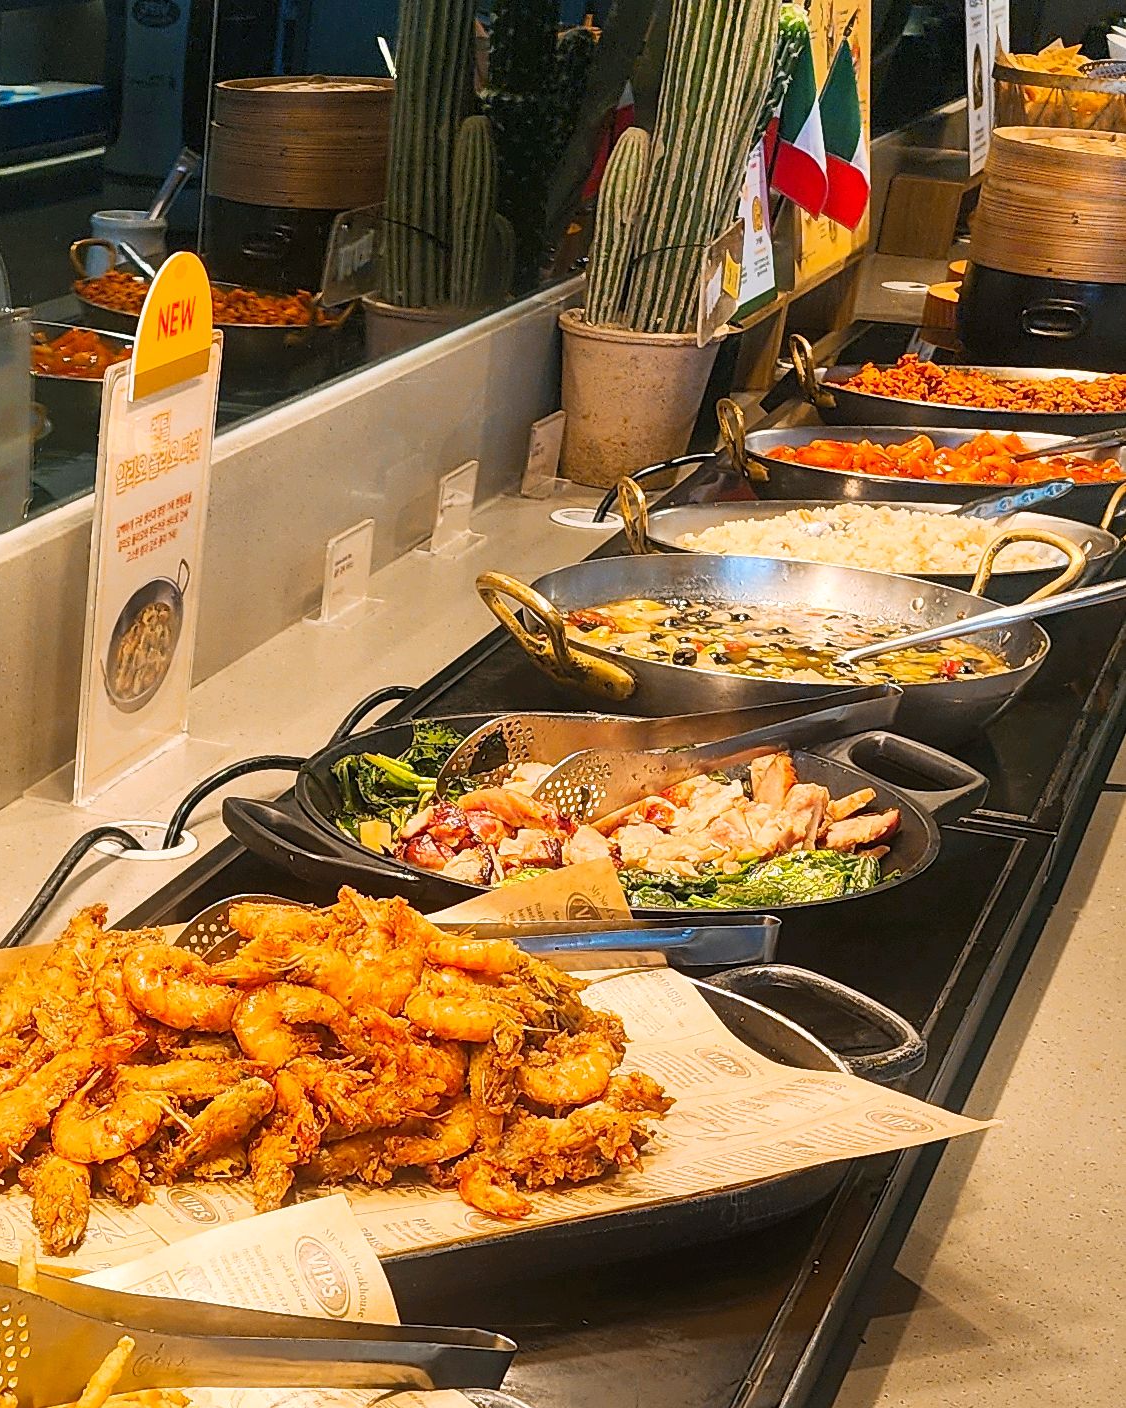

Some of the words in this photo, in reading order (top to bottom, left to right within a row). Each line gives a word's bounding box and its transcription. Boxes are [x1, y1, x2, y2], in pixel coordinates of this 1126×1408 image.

[157, 296, 197, 342] NEW
[707, 1053, 741, 1073] VIPS
[881, 1115, 920, 1132] VIPS
[177, 1195, 212, 1219] VIPS
[307, 1251, 343, 1298] VIPS
[350, 1262, 369, 1318] Steakhouse
